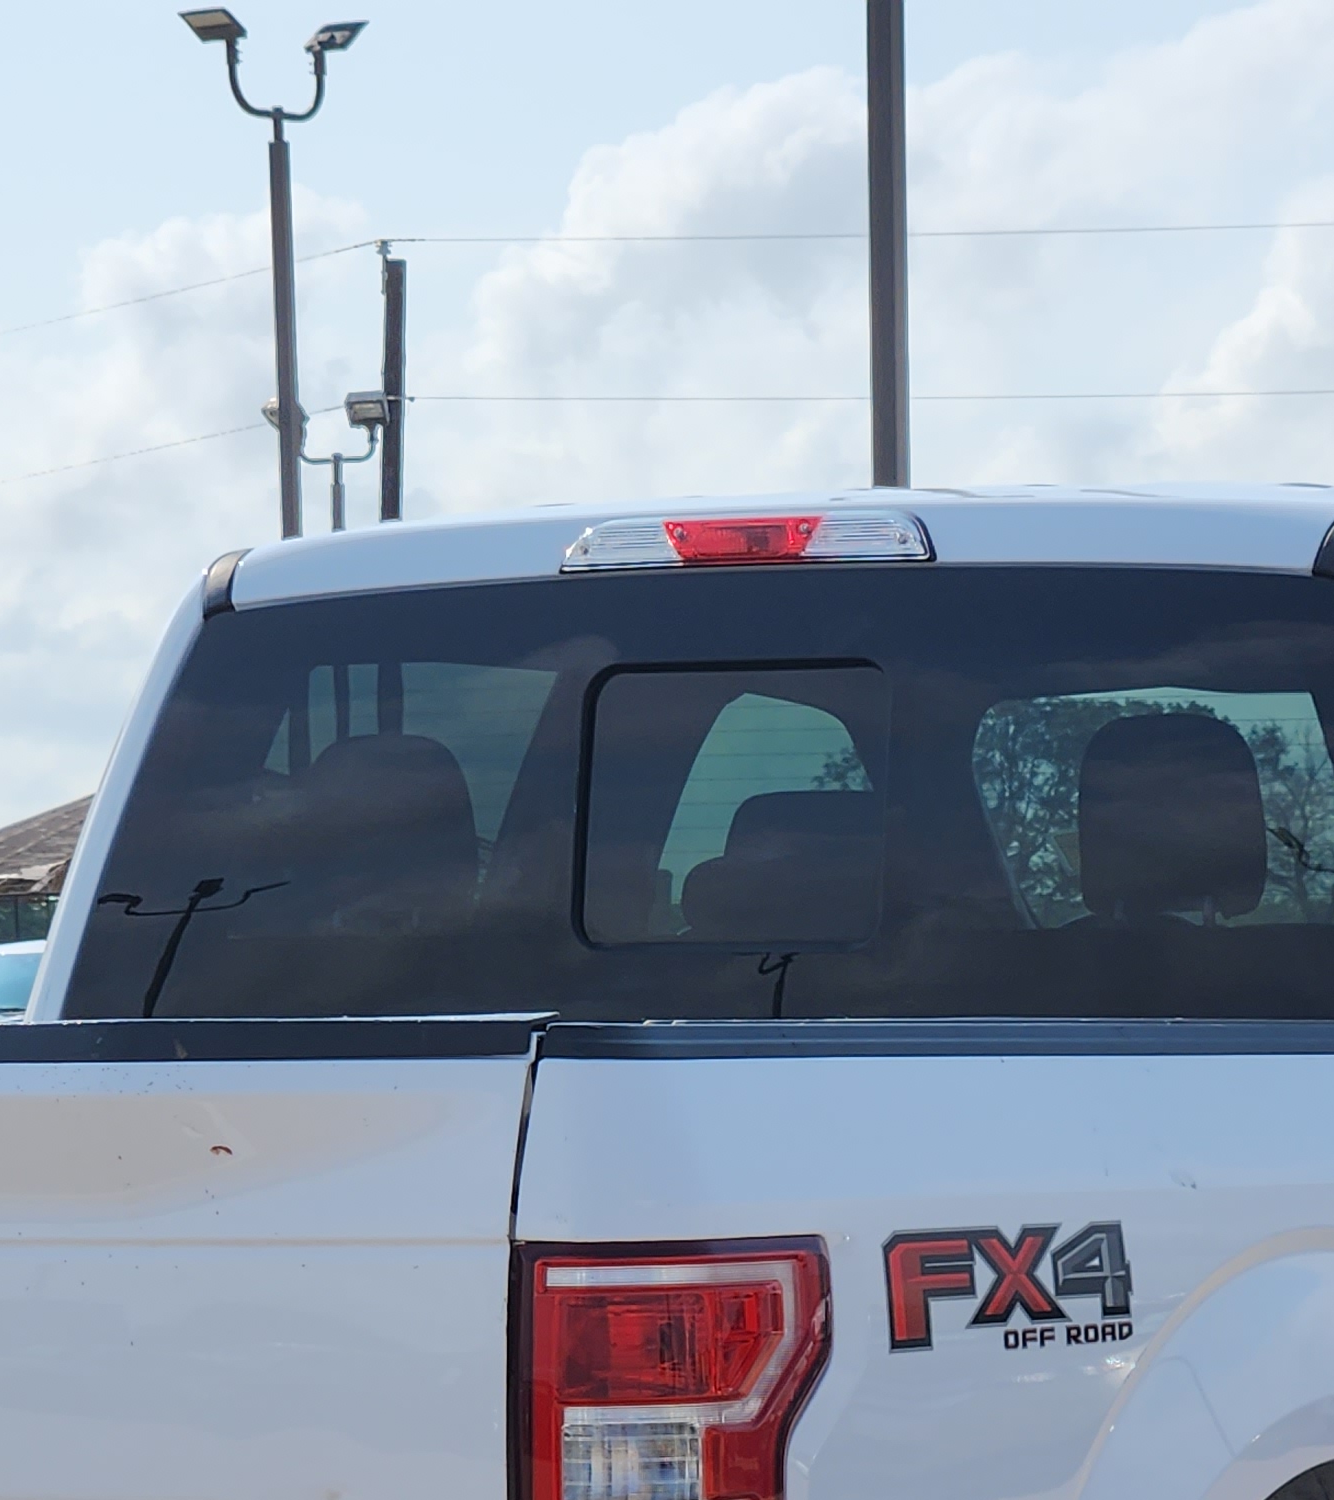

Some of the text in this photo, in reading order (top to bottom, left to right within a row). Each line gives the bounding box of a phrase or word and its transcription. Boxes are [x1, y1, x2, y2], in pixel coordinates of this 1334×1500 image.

[881, 1219, 1134, 1354] FX4
[1003, 1321, 1134, 1350] OFF ROAD
